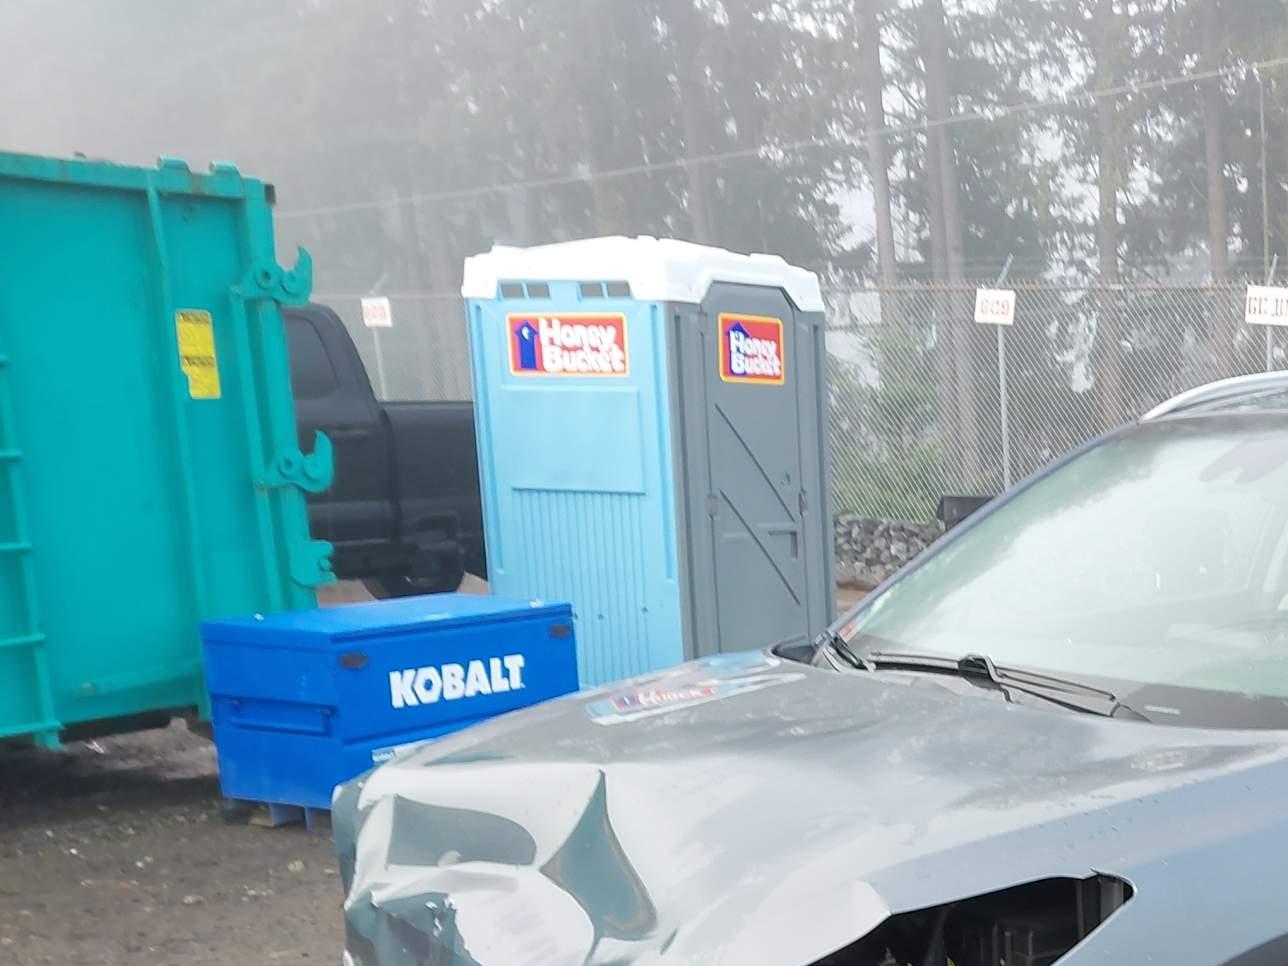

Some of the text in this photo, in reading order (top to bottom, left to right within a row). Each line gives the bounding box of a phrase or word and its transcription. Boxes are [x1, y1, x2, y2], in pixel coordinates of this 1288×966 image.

[538, 317, 616, 353] Honey
[729, 330, 777, 360] Honey
[541, 343, 625, 373] Bucket
[730, 353, 782, 376] Bucket
[389, 654, 525, 709] KOBALT
